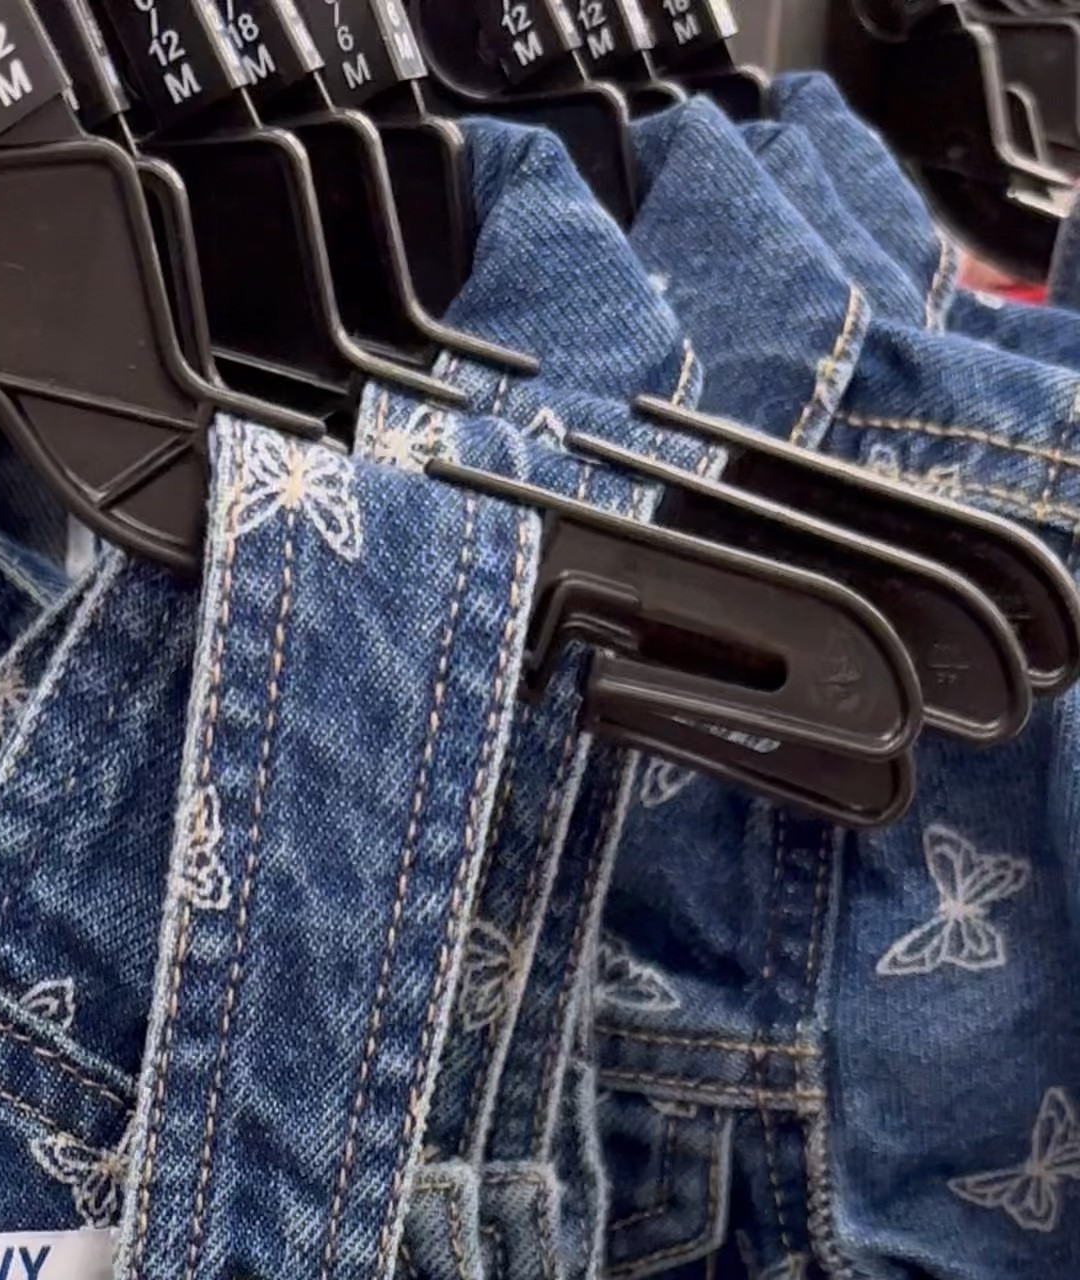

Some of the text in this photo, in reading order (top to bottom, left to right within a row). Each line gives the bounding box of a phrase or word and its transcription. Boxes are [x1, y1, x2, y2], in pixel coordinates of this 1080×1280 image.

[587, 27, 614, 60] M
[672, 12, 701, 45] M
[242, 44, 276, 86] M
[513, 31, 544, 67] M
[163, 62, 202, 105] M
[342, 52, 372, 90] M
